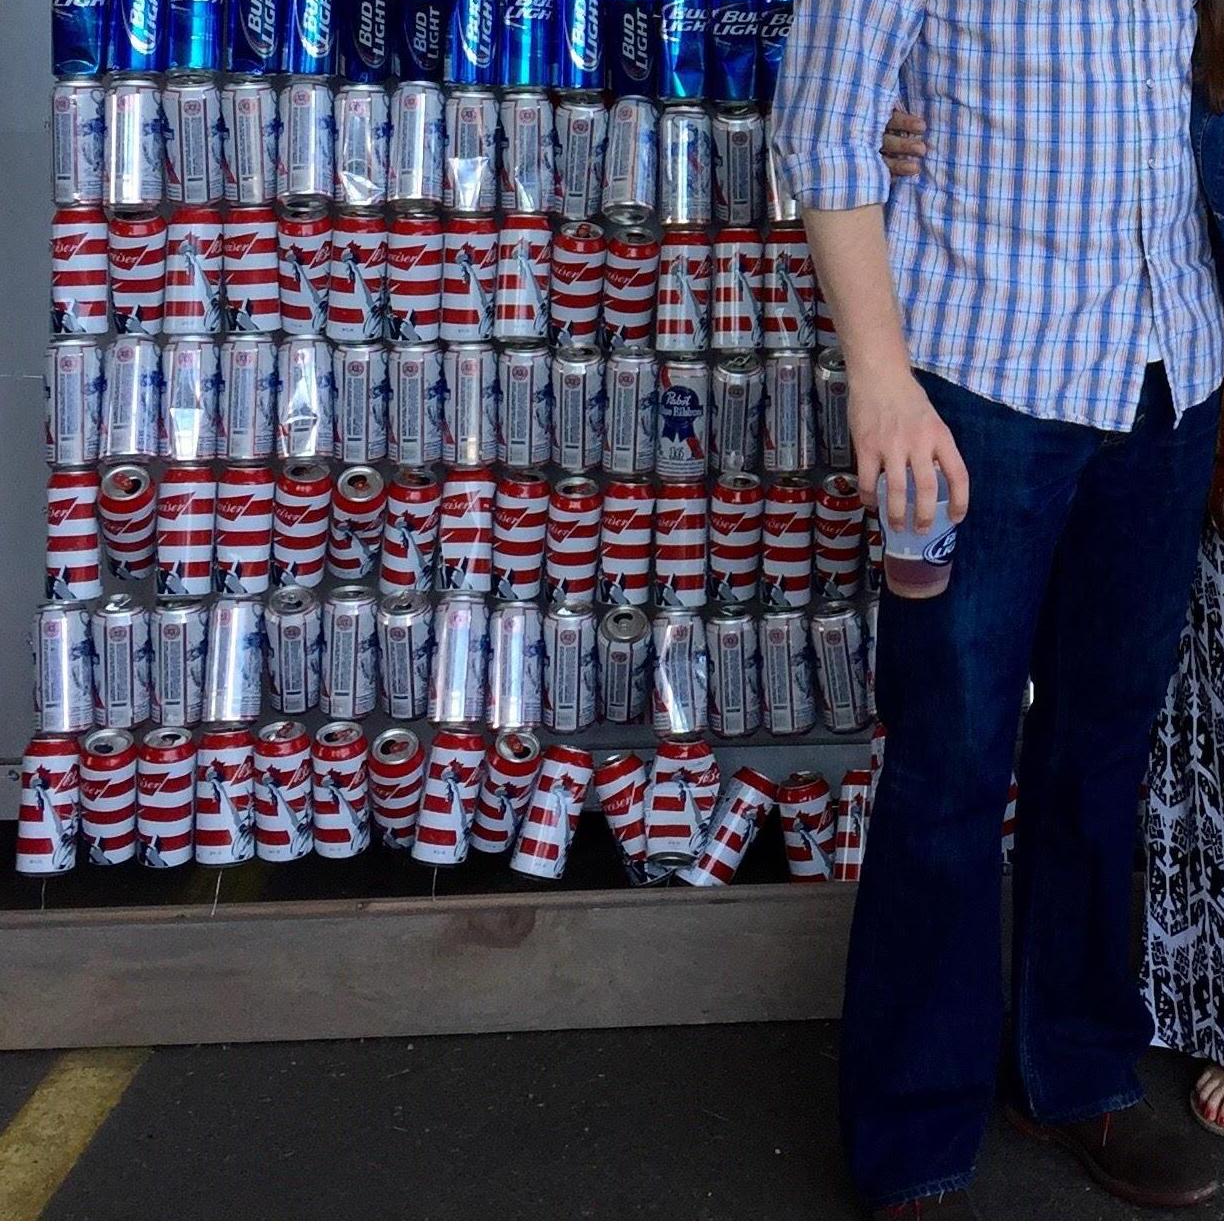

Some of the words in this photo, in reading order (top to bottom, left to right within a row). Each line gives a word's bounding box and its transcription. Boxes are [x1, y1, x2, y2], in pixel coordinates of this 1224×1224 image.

[359, 1, 372, 48] BUD
[623, 13, 634, 61] BUD
[635, 7, 649, 78] LIGHT
[666, 392, 691, 406] Pabst
